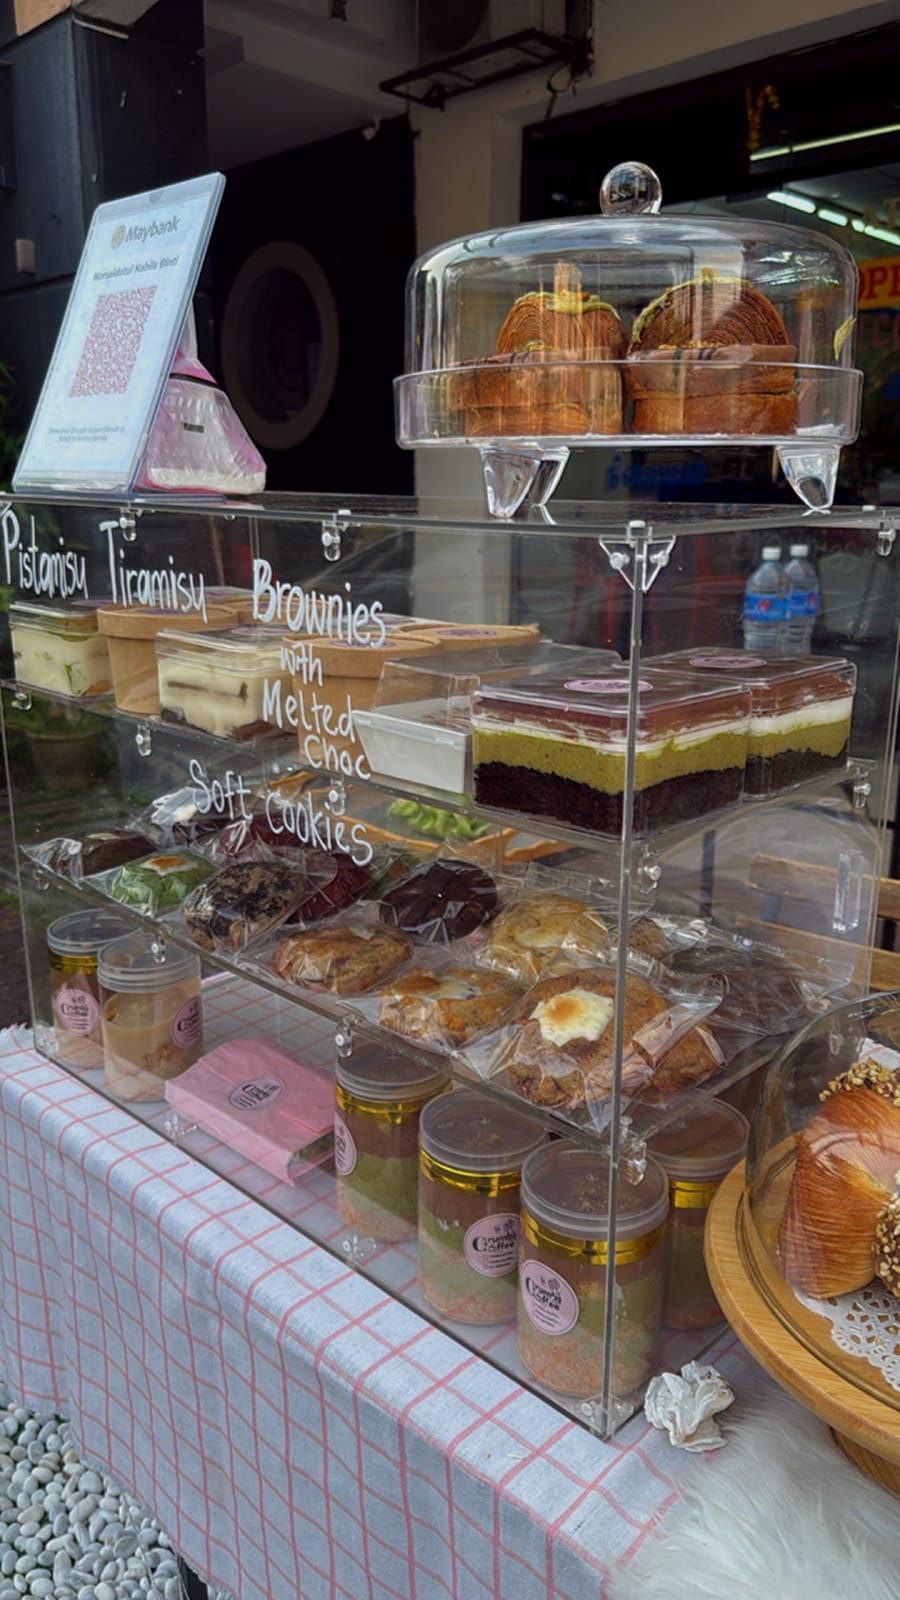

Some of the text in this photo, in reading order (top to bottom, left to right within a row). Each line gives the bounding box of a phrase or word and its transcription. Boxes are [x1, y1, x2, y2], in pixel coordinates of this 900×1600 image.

[125, 216, 180, 242] Maybank
[253, 559, 386, 648] Brownies
[280, 642, 323, 687] with
[263, 679, 355, 742] Melted
[305, 735, 371, 780] Choc
[190, 760, 252, 820] Soft
